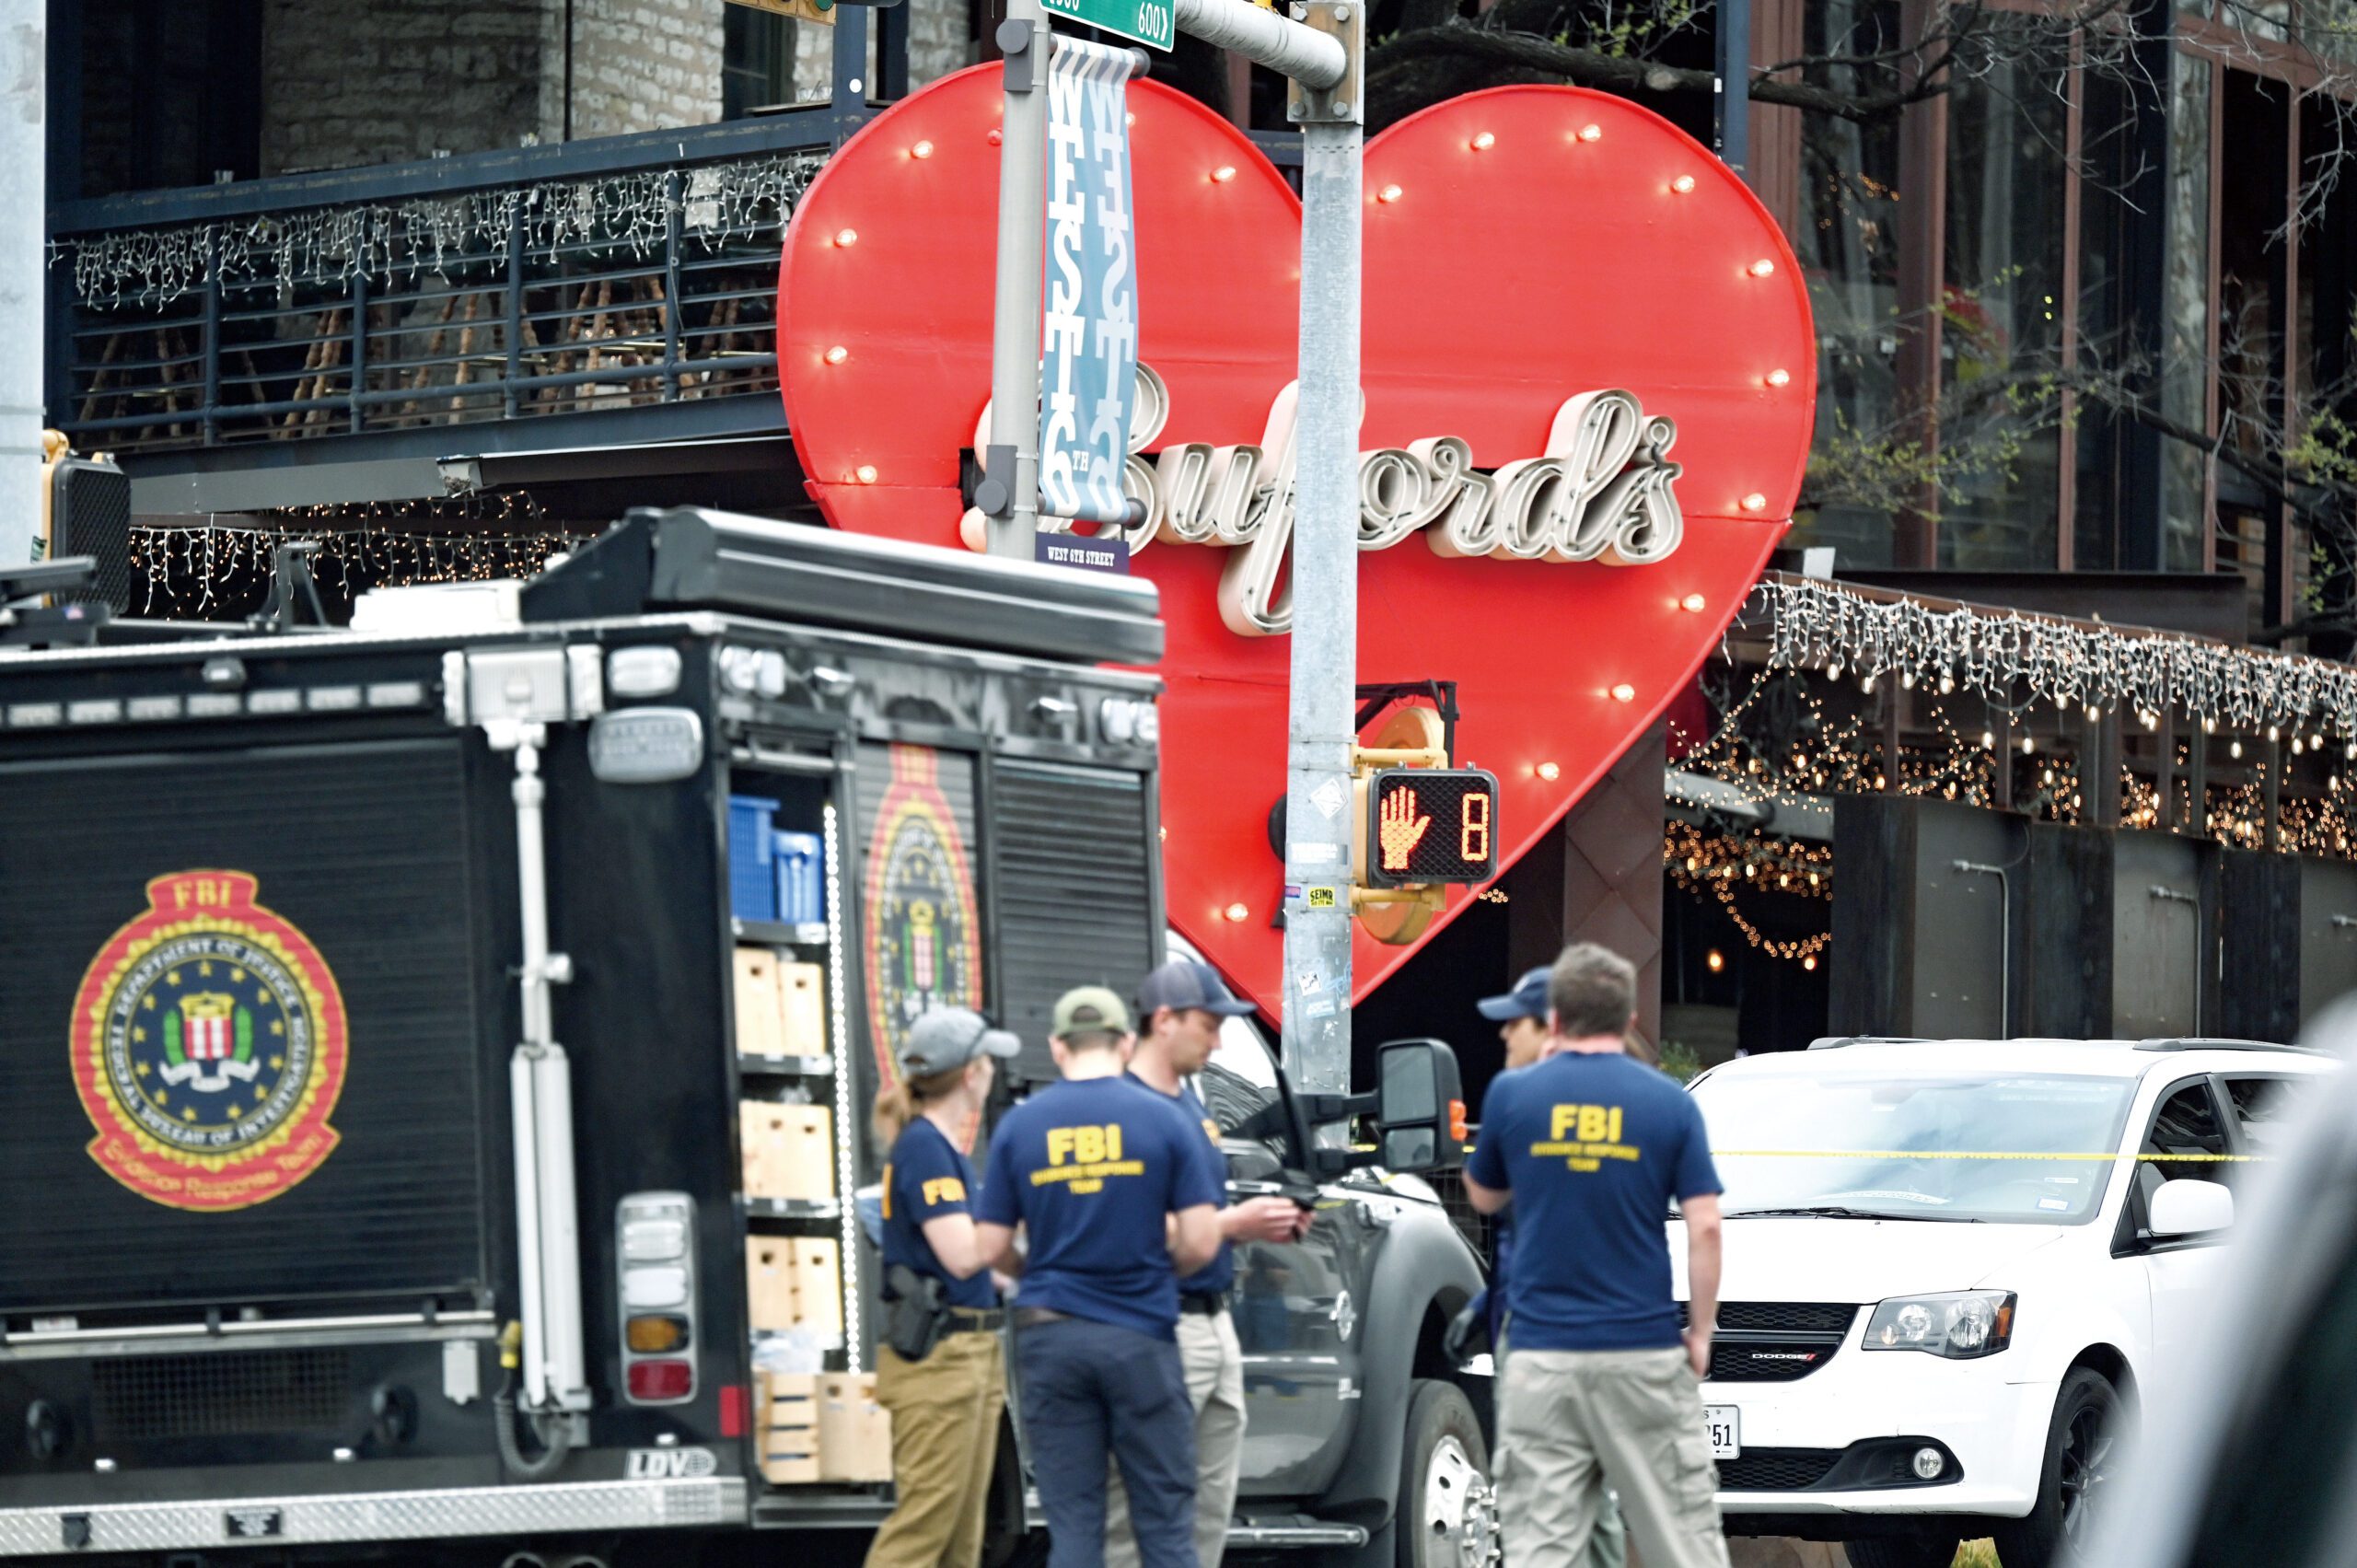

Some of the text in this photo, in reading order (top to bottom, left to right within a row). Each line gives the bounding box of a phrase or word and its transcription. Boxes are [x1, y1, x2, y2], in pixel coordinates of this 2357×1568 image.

[1138, 2, 1160, 39] 600
[1047, 35, 1095, 412] WEST
[1048, 546, 1115, 566] WEST 6TH STREET
[1461, 793, 1489, 861] 8
[173, 879, 231, 912] FBI
[1550, 1104, 1621, 1143] FBI
[1047, 1123, 1121, 1166] FBI
[629, 1451, 691, 1478] LDV
